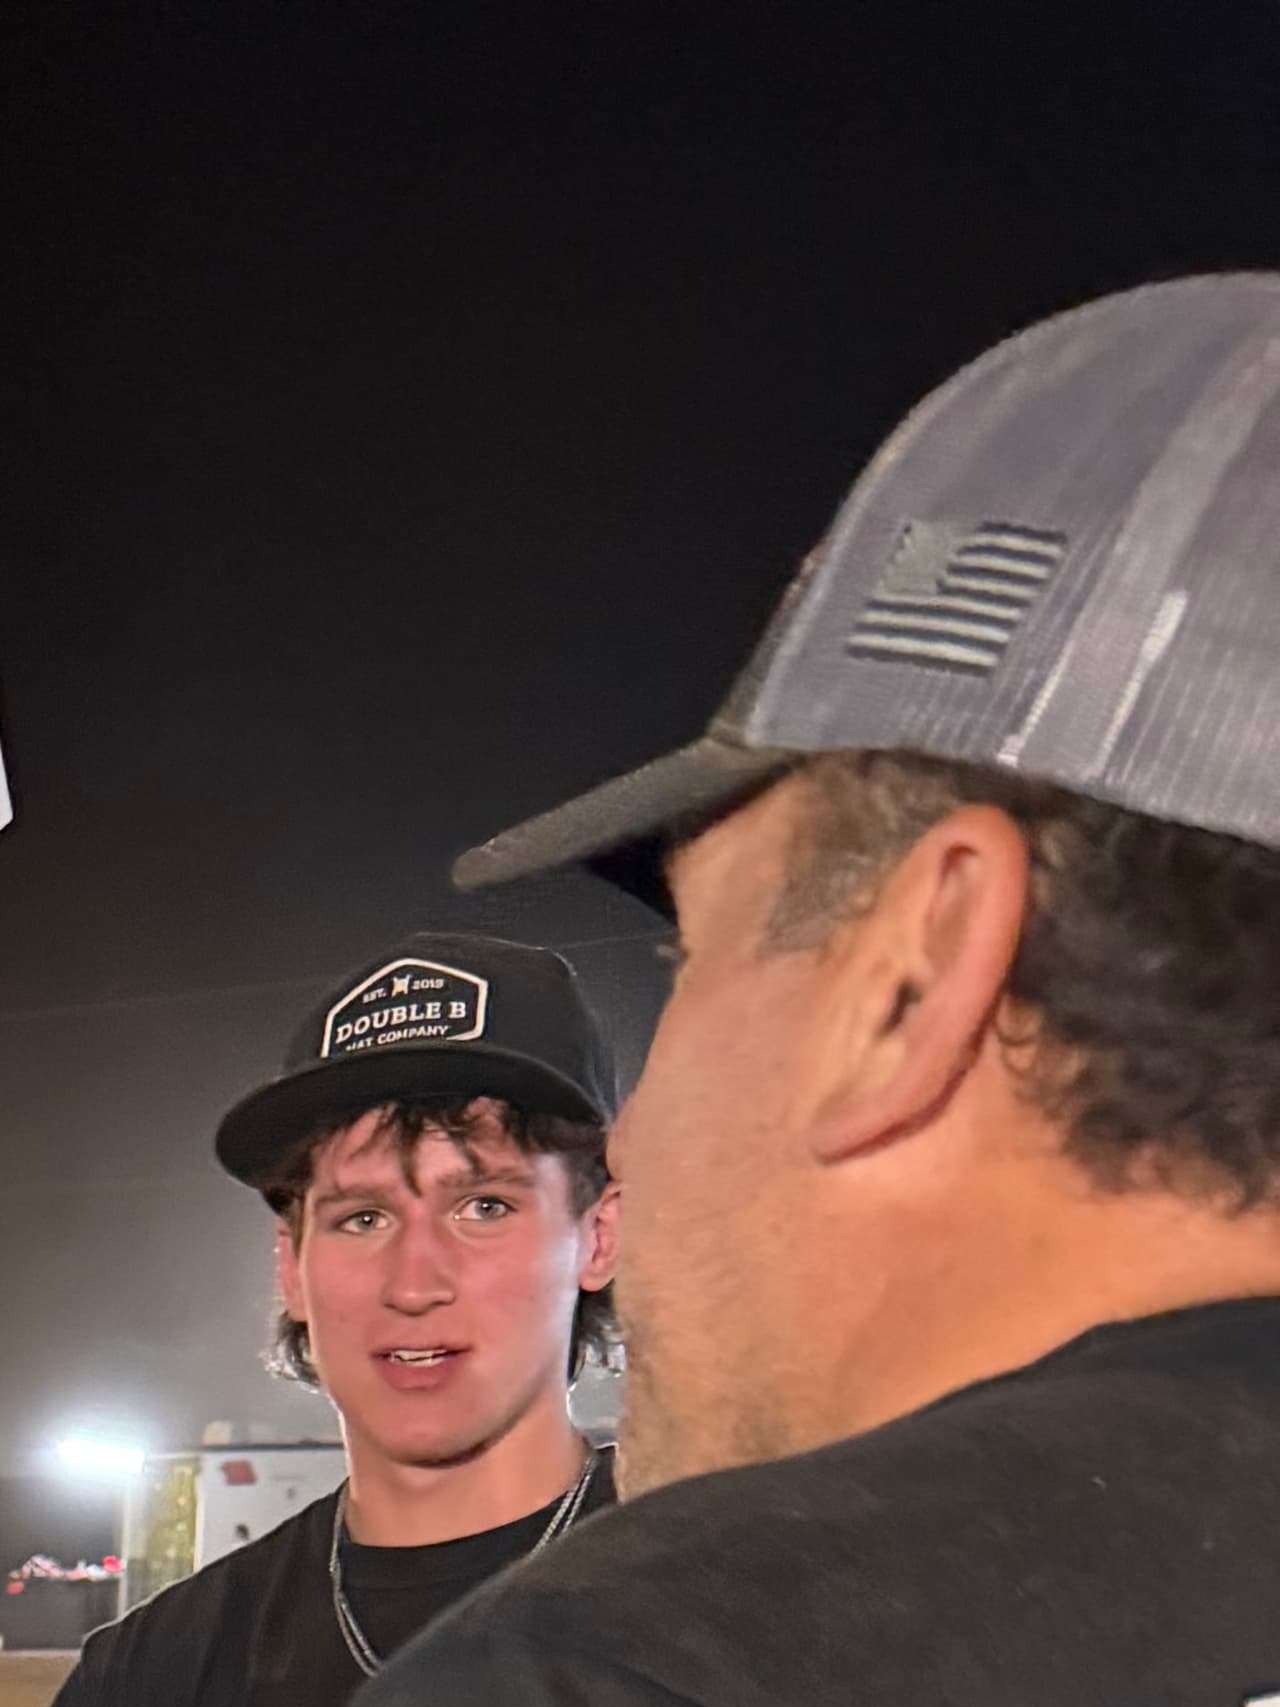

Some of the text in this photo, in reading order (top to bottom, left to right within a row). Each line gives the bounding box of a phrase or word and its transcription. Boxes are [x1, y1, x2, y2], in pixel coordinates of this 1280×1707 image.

[336, 1001, 466, 1044] DOUBLE B
[377, 1025, 449, 1044] COMPANY
